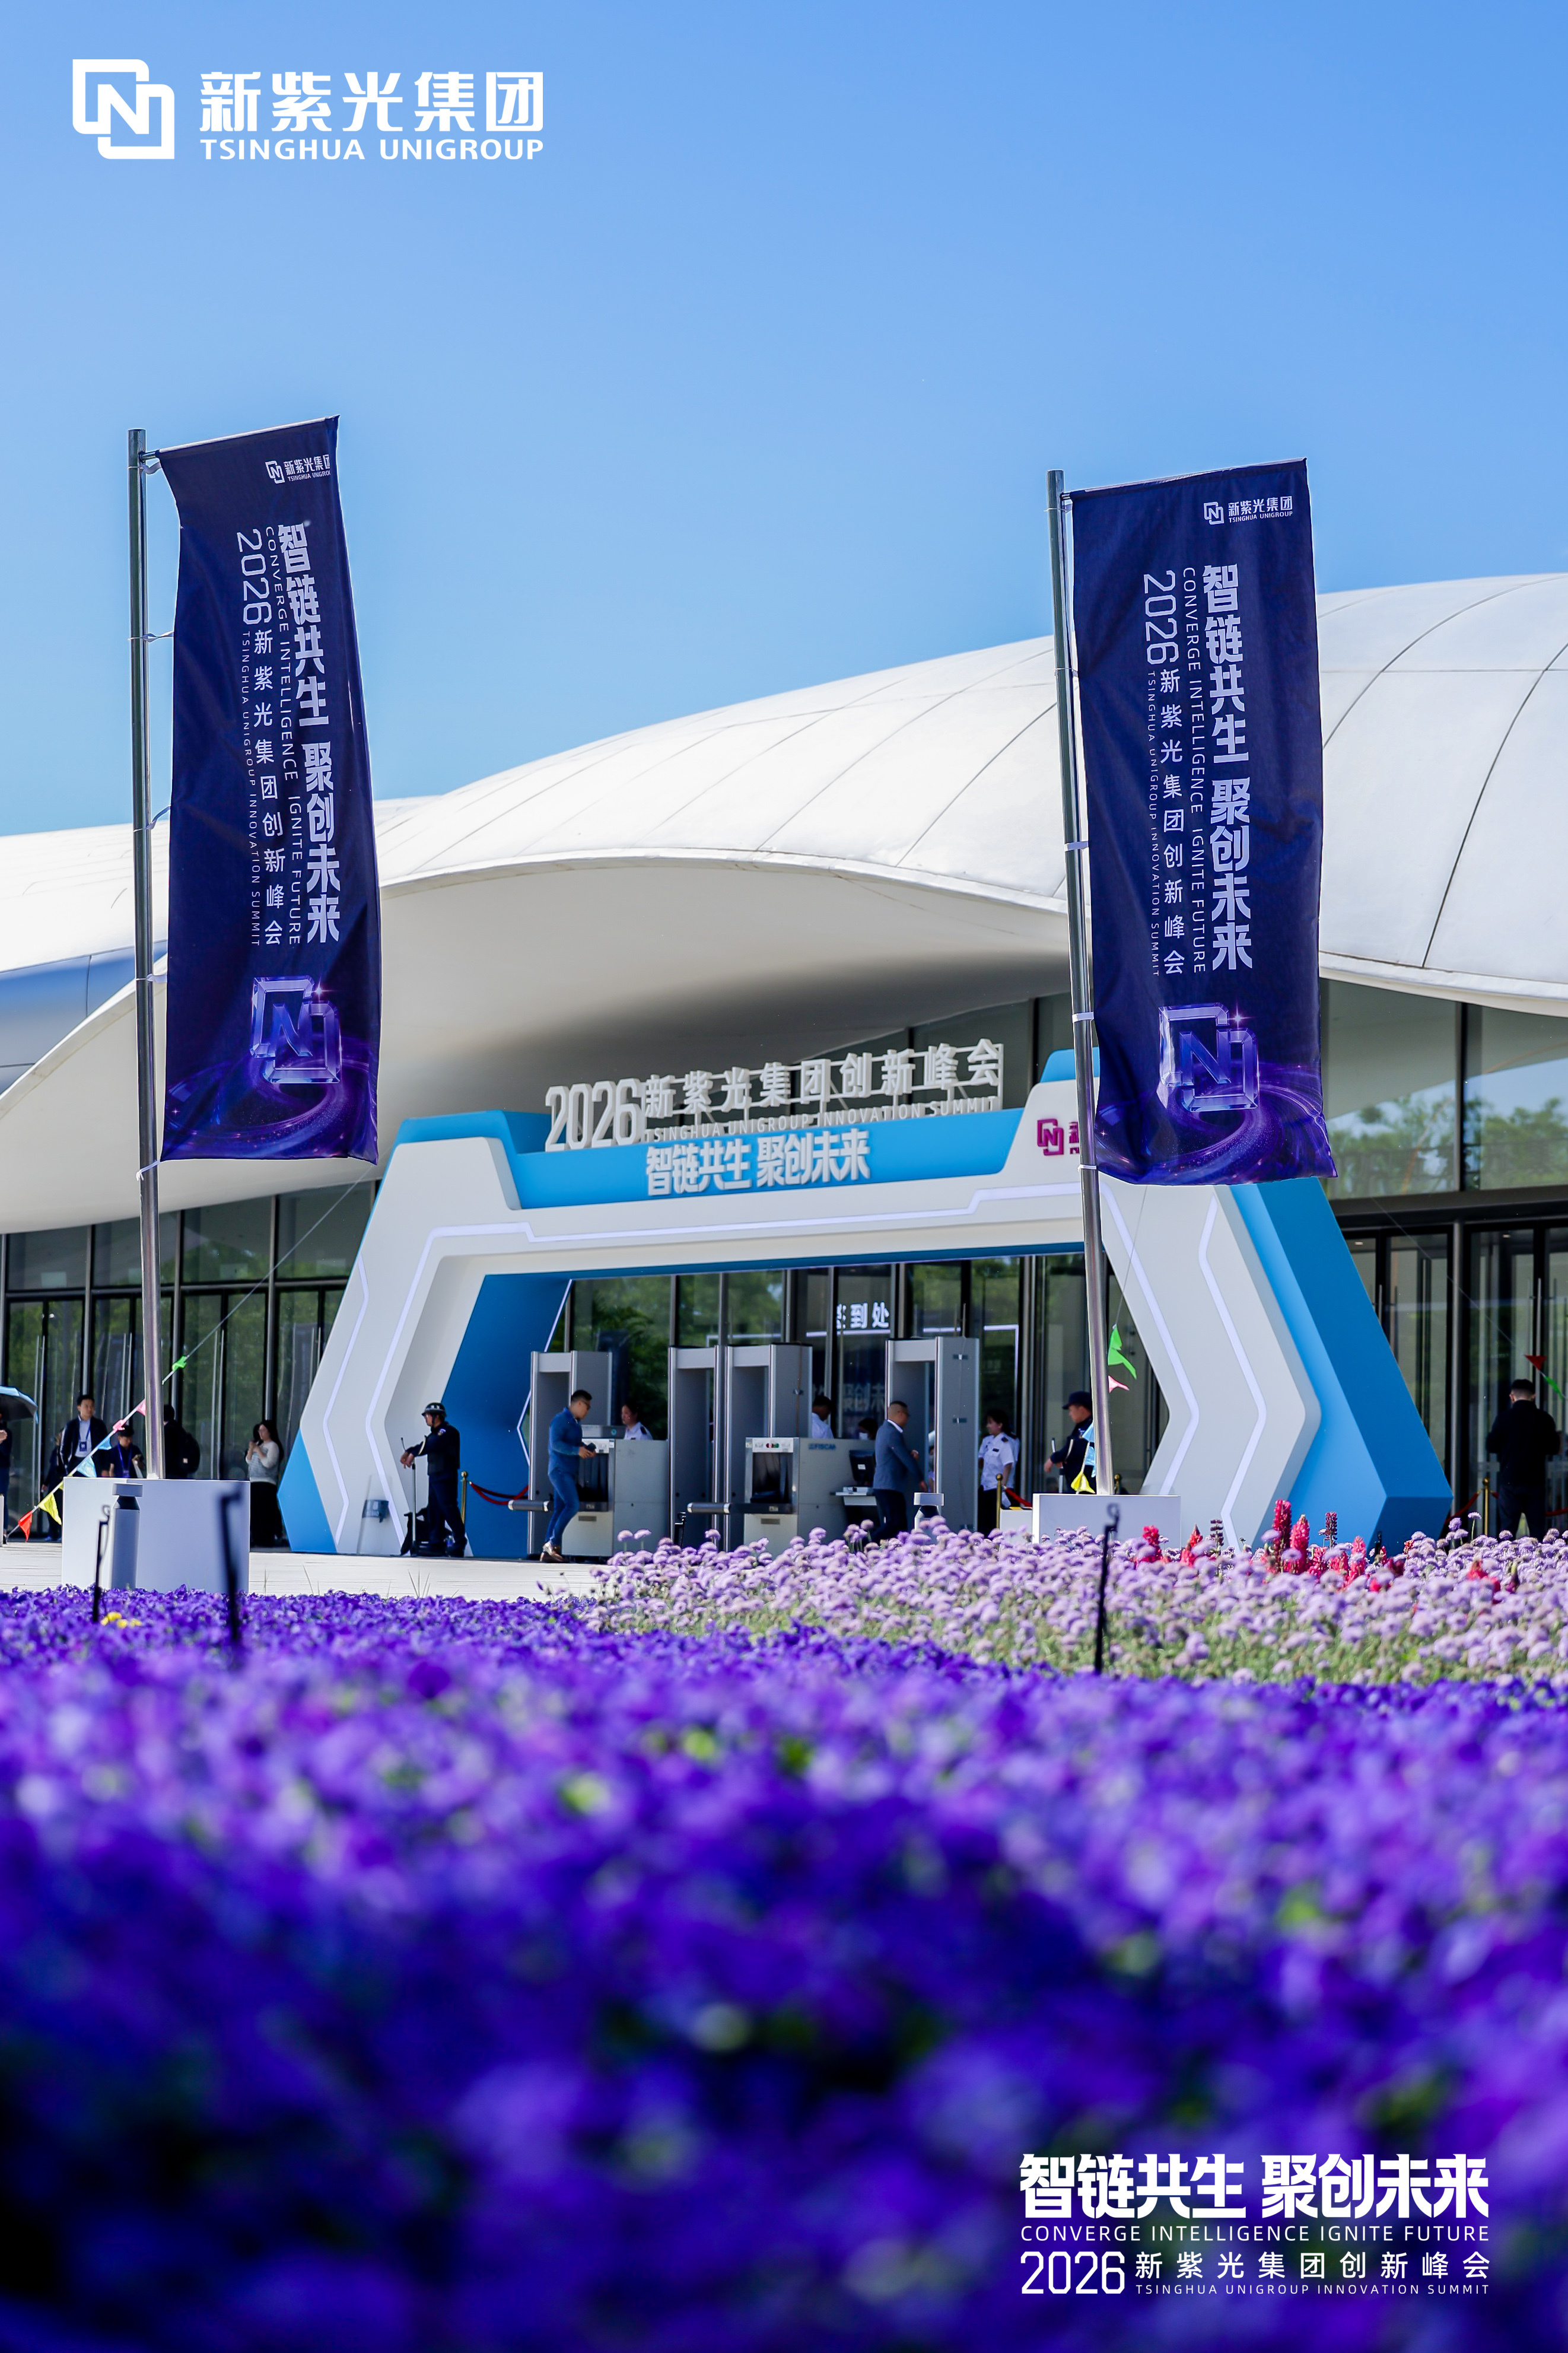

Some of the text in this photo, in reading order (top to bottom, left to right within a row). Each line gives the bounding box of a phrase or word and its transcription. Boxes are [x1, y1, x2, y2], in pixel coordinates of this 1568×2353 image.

[1228, 496, 1292, 516] 新紫光集团
[1229, 514, 1257, 523] TSINGHUA
[237, 529, 285, 945] 2026 新紫光集团创新峰会
[242, 631, 260, 945] TSINGHUA UNIGROUP INNOVATION SUMMIT
[266, 526, 303, 945] CONVERGE INTELLIGENCE IGNITE FUTURE
[278, 523, 340, 943] 智链共生 聚创未来
[1144, 570, 1185, 974] 2026 新紫光集团创新峰会
[1147, 670, 1160, 976] TSINGHUA UNIGROUP INNOVATION SUMMIT
[1184, 567, 1206, 973] CONVERGE INTELLIGENCE IGNITE FUTURE
[1202, 564, 1252, 971] 智链共生 聚创未来
[545, 1038, 1000, 1152] 2026 新紫光集团创新峰会
[645, 1096, 996, 1142] TSINGHUA UNIGROUP INNOVATION SUMMIT
[646, 1128, 870, 1196] 智链共生 聚创未来
